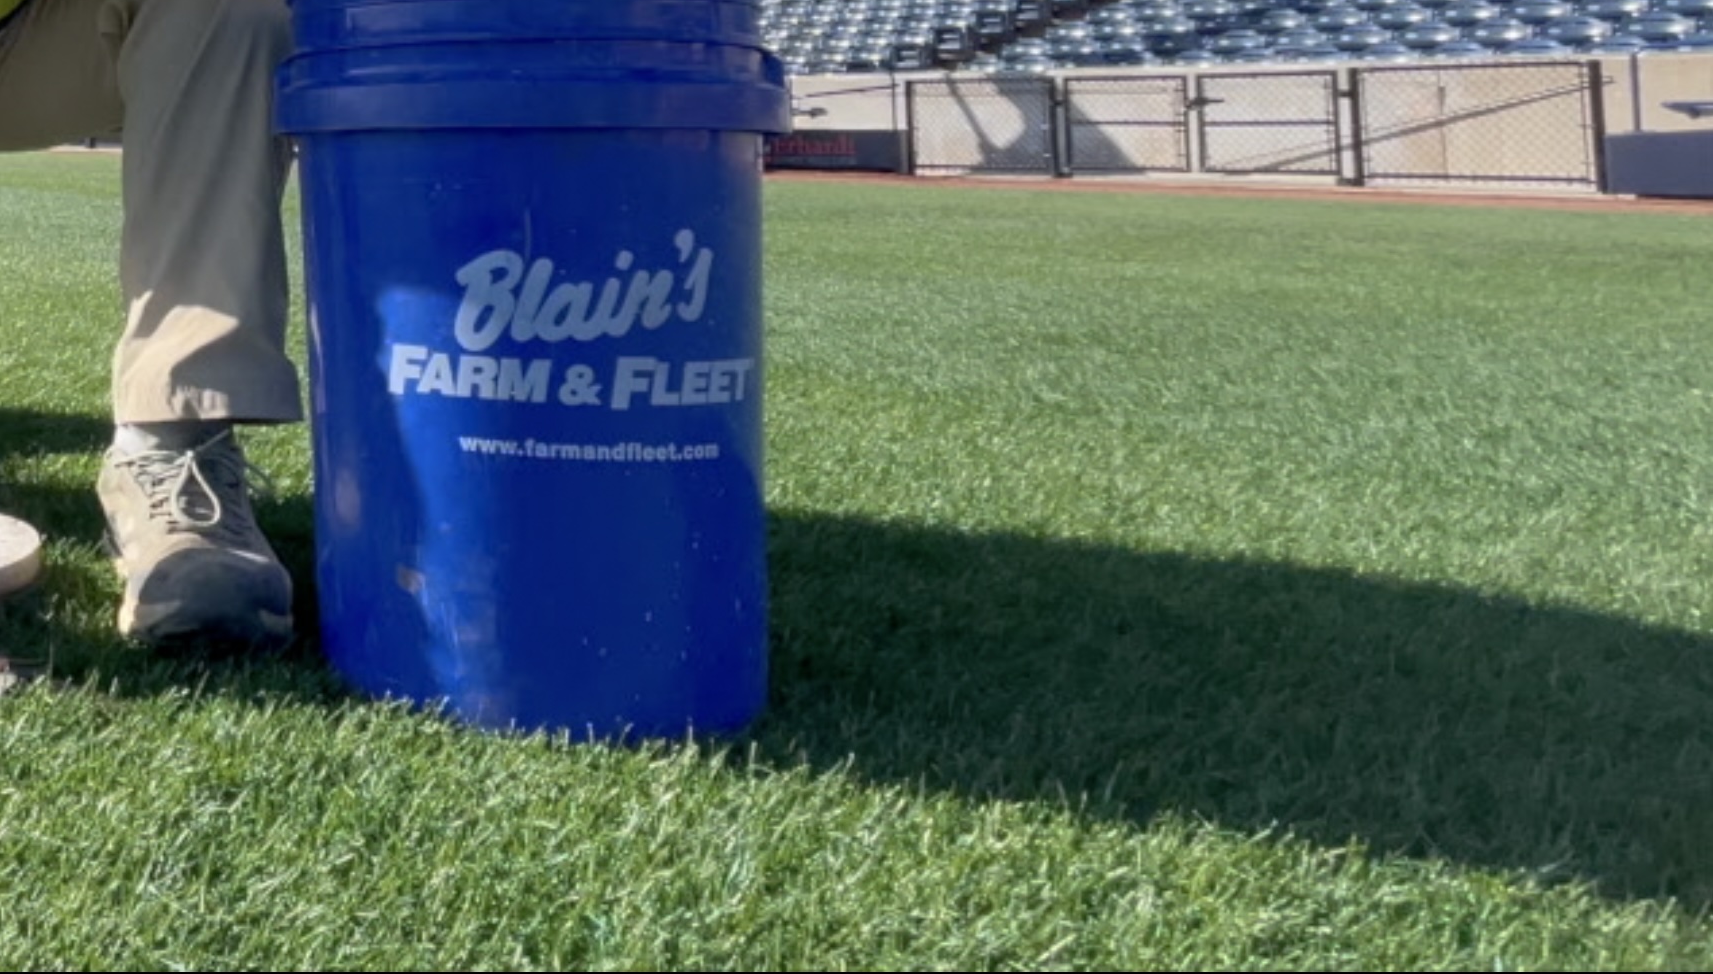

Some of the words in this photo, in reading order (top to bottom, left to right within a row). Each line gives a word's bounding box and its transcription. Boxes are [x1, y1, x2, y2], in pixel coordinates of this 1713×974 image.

[453, 228, 714, 352] Blain's
[388, 343, 552, 404] FARM
[557, 364, 602, 406] &
[610, 356, 755, 411] FLEET
[458, 435, 721, 462] www.farmandfleet.com
